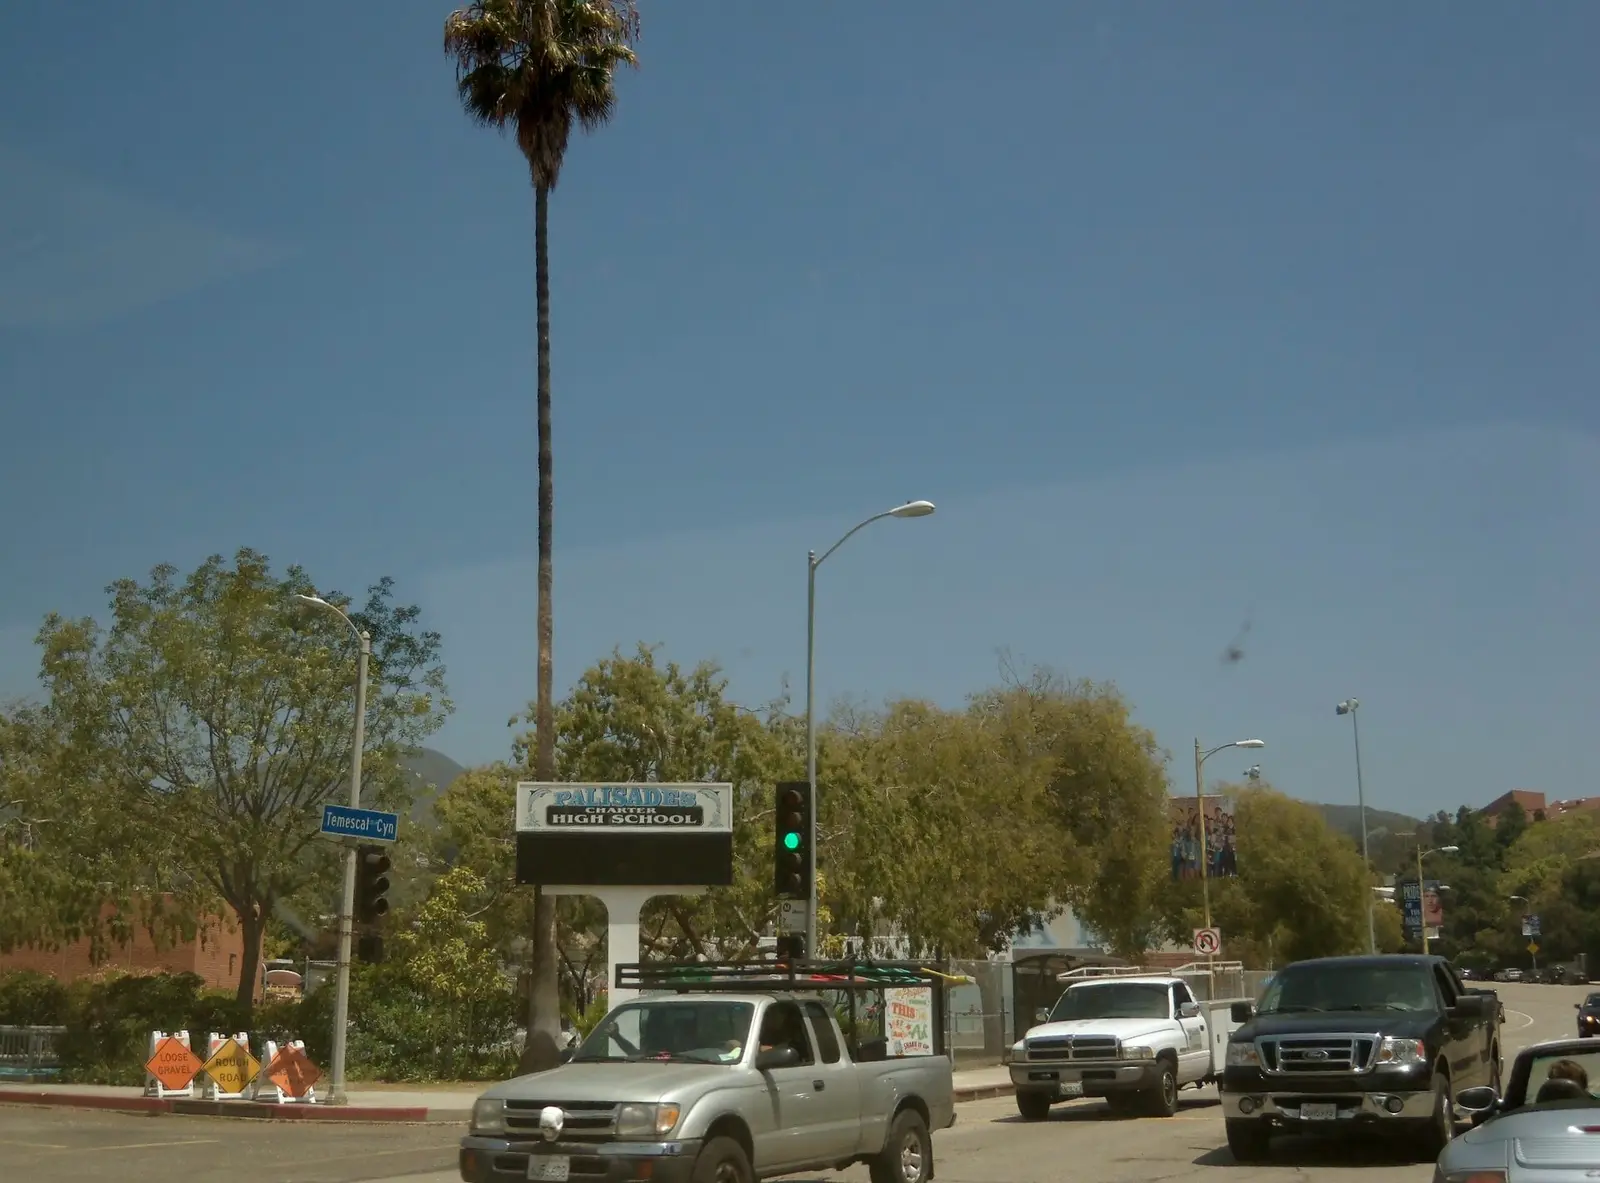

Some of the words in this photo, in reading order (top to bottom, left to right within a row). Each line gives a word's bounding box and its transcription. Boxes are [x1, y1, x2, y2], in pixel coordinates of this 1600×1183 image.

[553, 787, 697, 807] PALISADES
[326, 811, 370, 831] Temescal
[376, 818, 394, 837] Cyn
[552, 814, 604, 824] HIGH
[611, 814, 697, 824] SCHOOL
[892, 1002, 916, 1019] THIS
[159, 1052, 188, 1061] LOOSE
[215, 1058, 249, 1067] ROUGH
[158, 1064, 192, 1075] GRAVEL
[219, 1073, 247, 1082] ROAD
